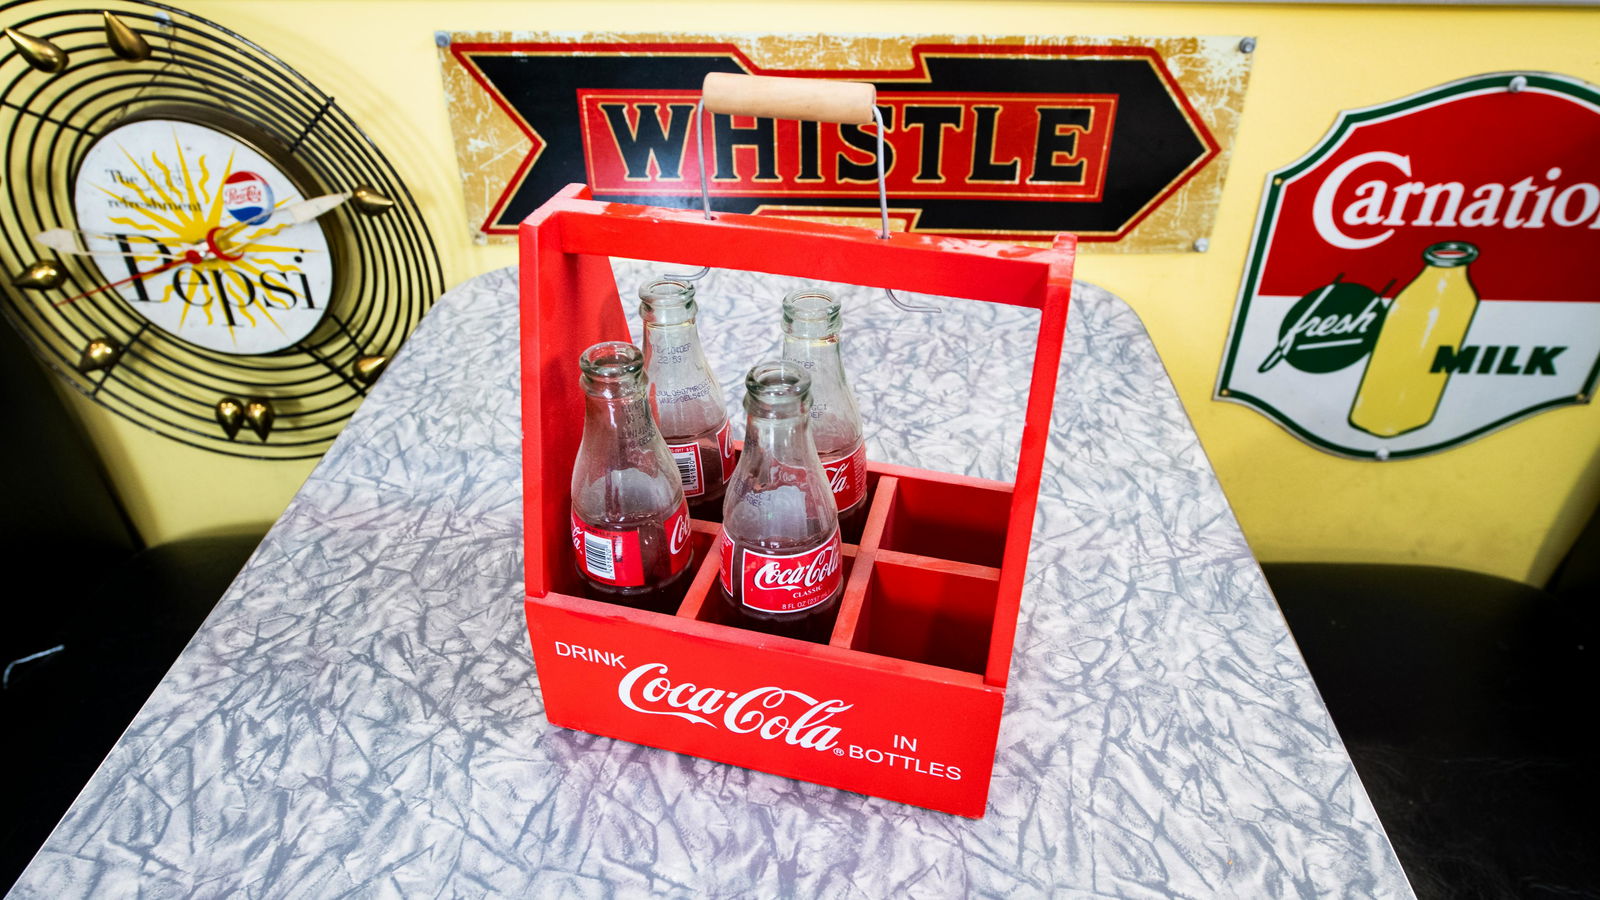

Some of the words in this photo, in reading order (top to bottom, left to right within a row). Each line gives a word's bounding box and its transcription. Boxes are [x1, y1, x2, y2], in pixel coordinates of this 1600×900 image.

[599, 103, 1096, 185] WHISTLE
[105, 168, 139, 186] The
[107, 196, 203, 213] refreshment
[1312, 150, 1600, 250] Carnatio
[104, 231, 324, 328] Pepsi
[1257, 272, 1398, 373] fresh
[1428, 345, 1569, 376] MILK
[754, 538, 840, 591] Coca-Cola
[792, 585, 824, 599] CLASSIC
[554, 640, 628, 670] DRINK
[617, 662, 855, 752] Coca-Cola
[893, 734, 918, 753] IN
[849, 744, 963, 781] BOTTLES
